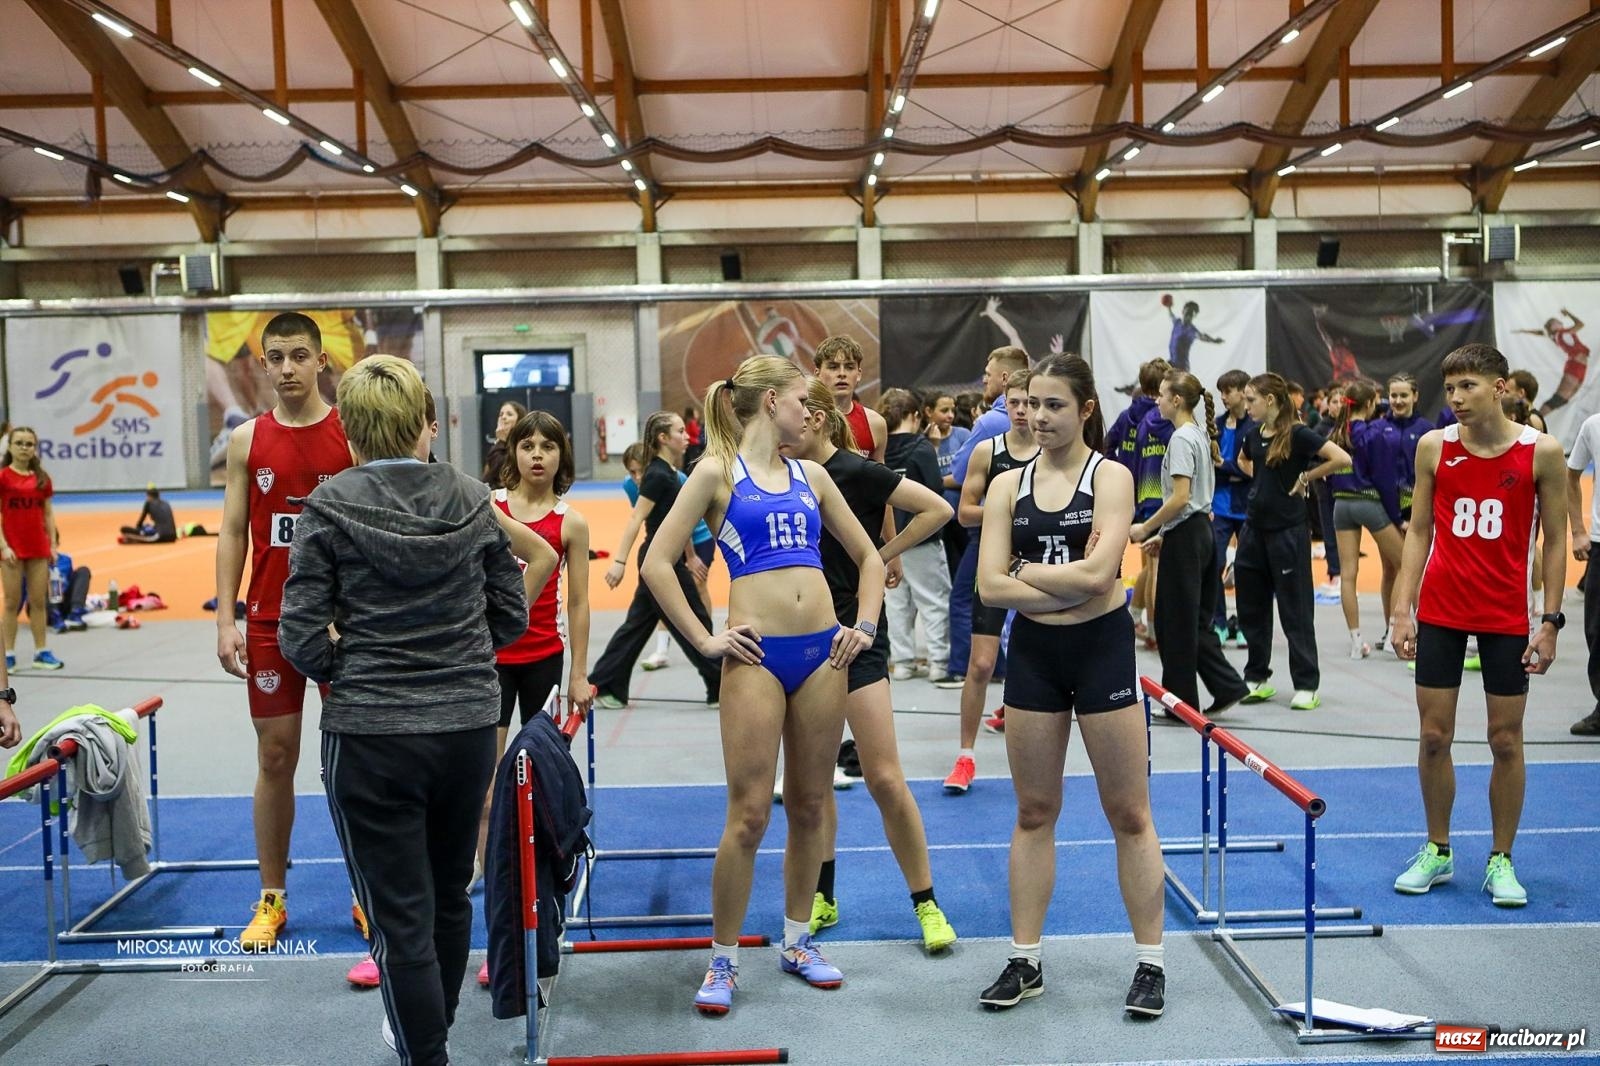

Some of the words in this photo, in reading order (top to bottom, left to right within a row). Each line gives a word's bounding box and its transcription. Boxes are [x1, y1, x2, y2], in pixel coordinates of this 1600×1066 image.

[112, 417, 150, 435] SMS
[37, 435, 163, 460] Racibórz
[1064, 511, 1079, 520] MOS
[1452, 497, 1504, 540] 88
[278, 516, 297, 544] 8
[765, 512, 808, 550] 153
[1037, 535, 1070, 565] 75
[1109, 687, 1132, 701] esa
